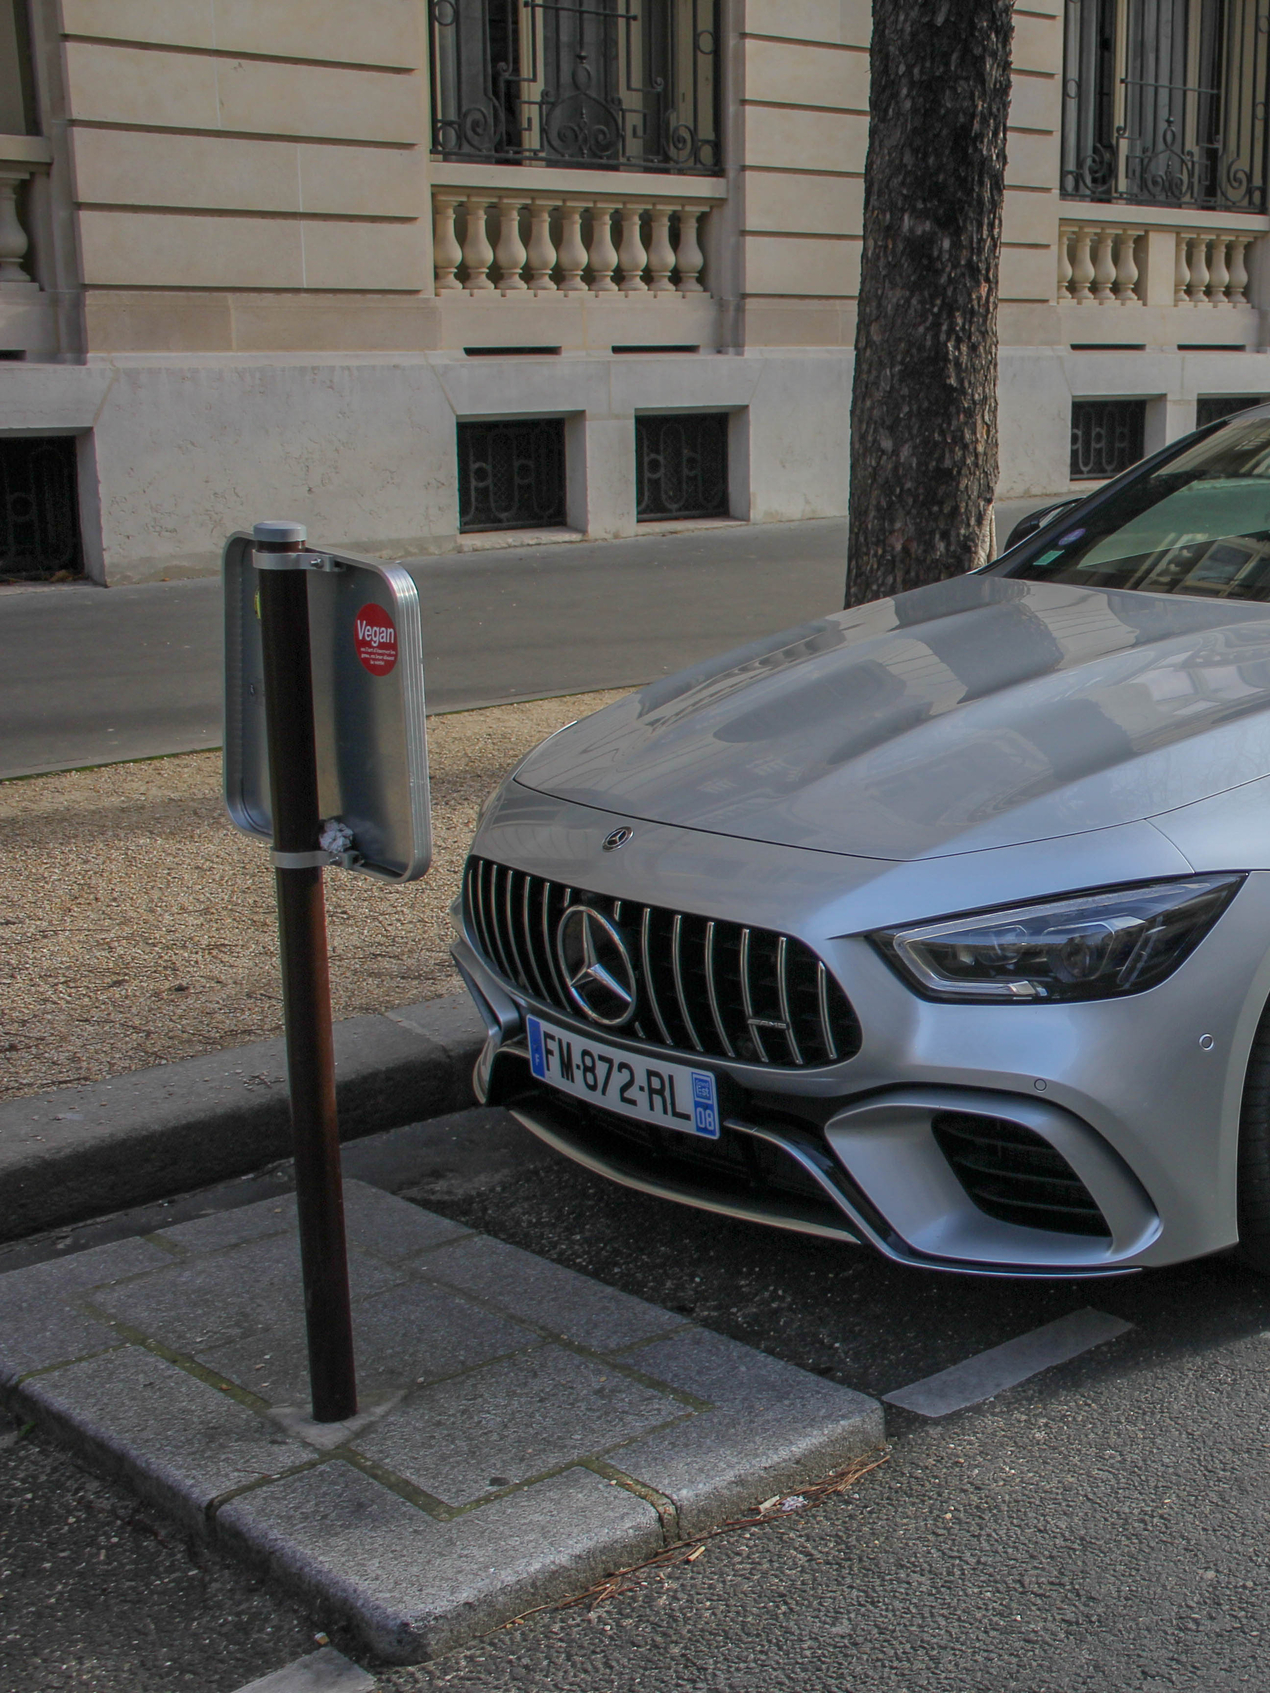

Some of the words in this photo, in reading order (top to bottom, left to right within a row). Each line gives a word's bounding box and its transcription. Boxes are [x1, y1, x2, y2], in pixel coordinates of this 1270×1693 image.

[357, 619, 395, 647] Vegan
[543, 1030, 692, 1122] FM-872-RL
[696, 1106, 715, 1131] 08
